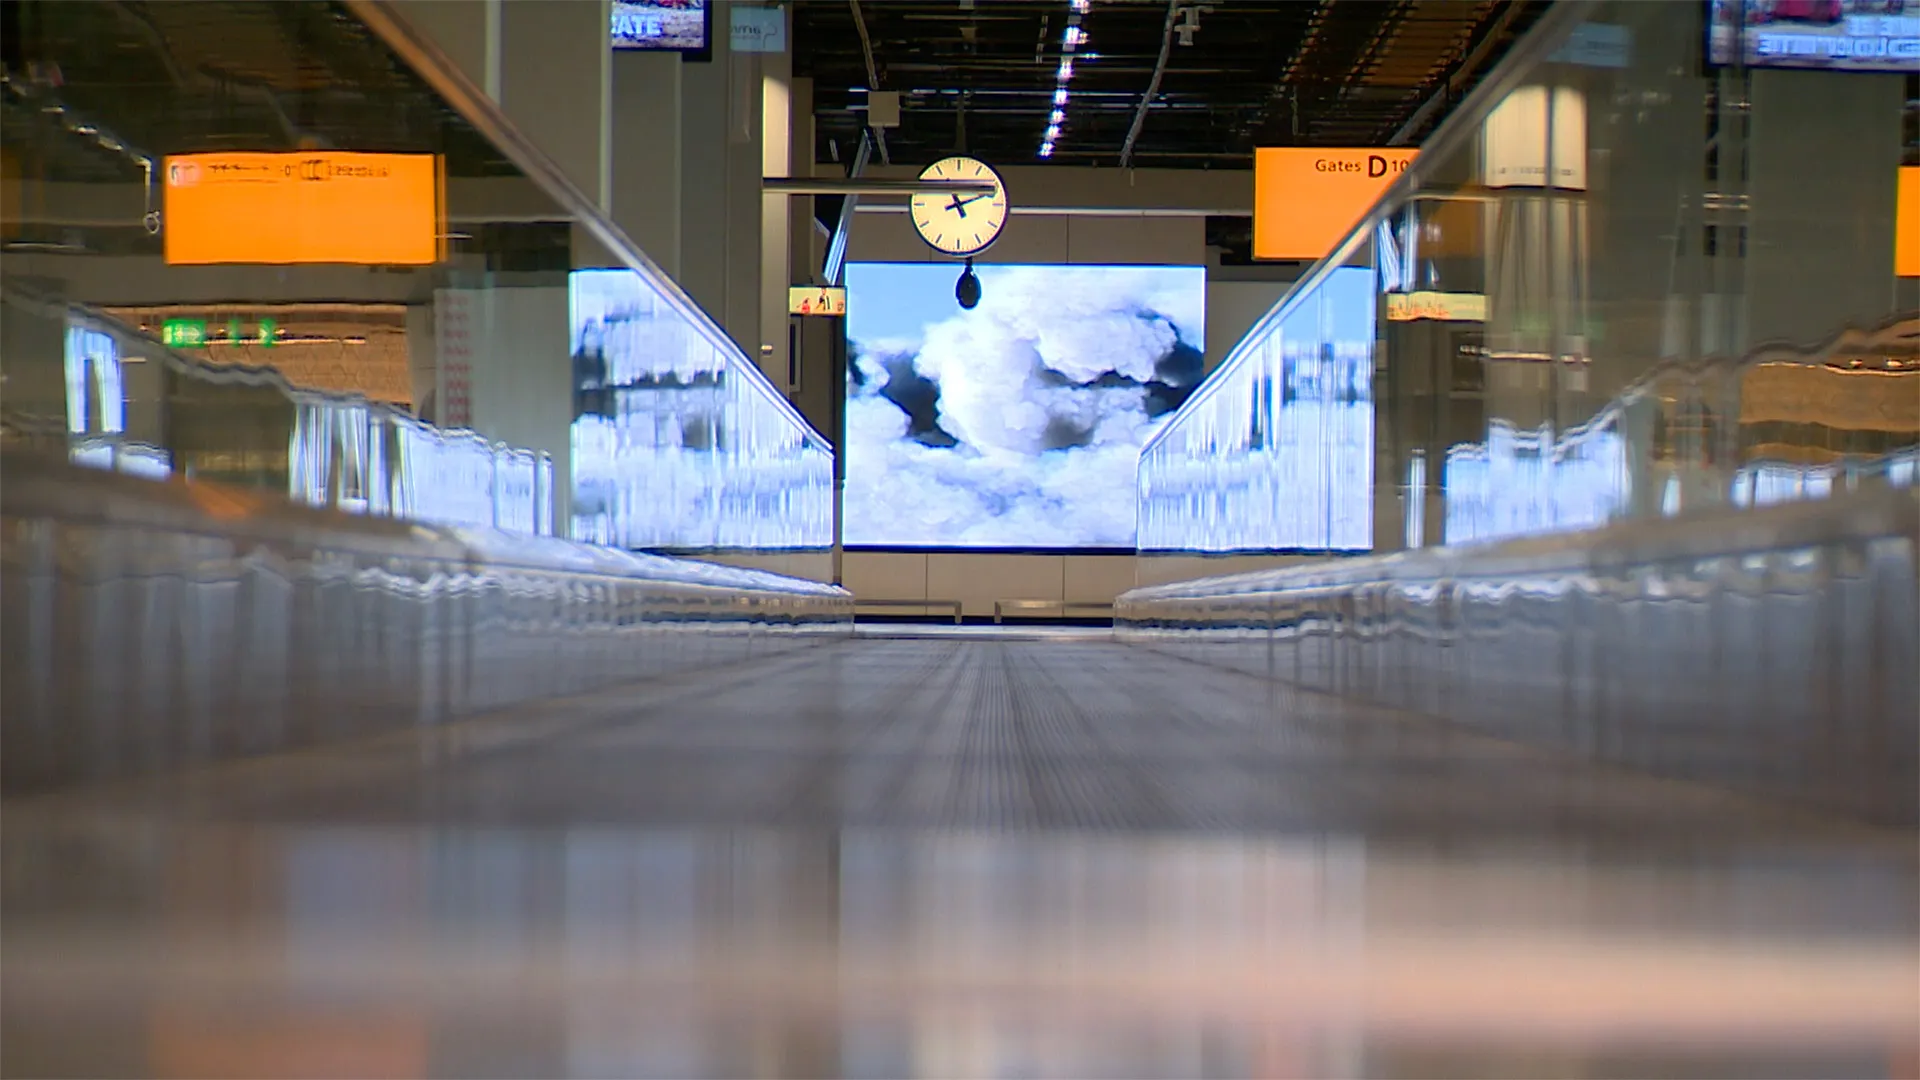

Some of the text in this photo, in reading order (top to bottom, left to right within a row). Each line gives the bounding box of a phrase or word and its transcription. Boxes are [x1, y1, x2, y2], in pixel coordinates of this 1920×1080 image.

[1315, 154, 1410, 178] Gates D 10
